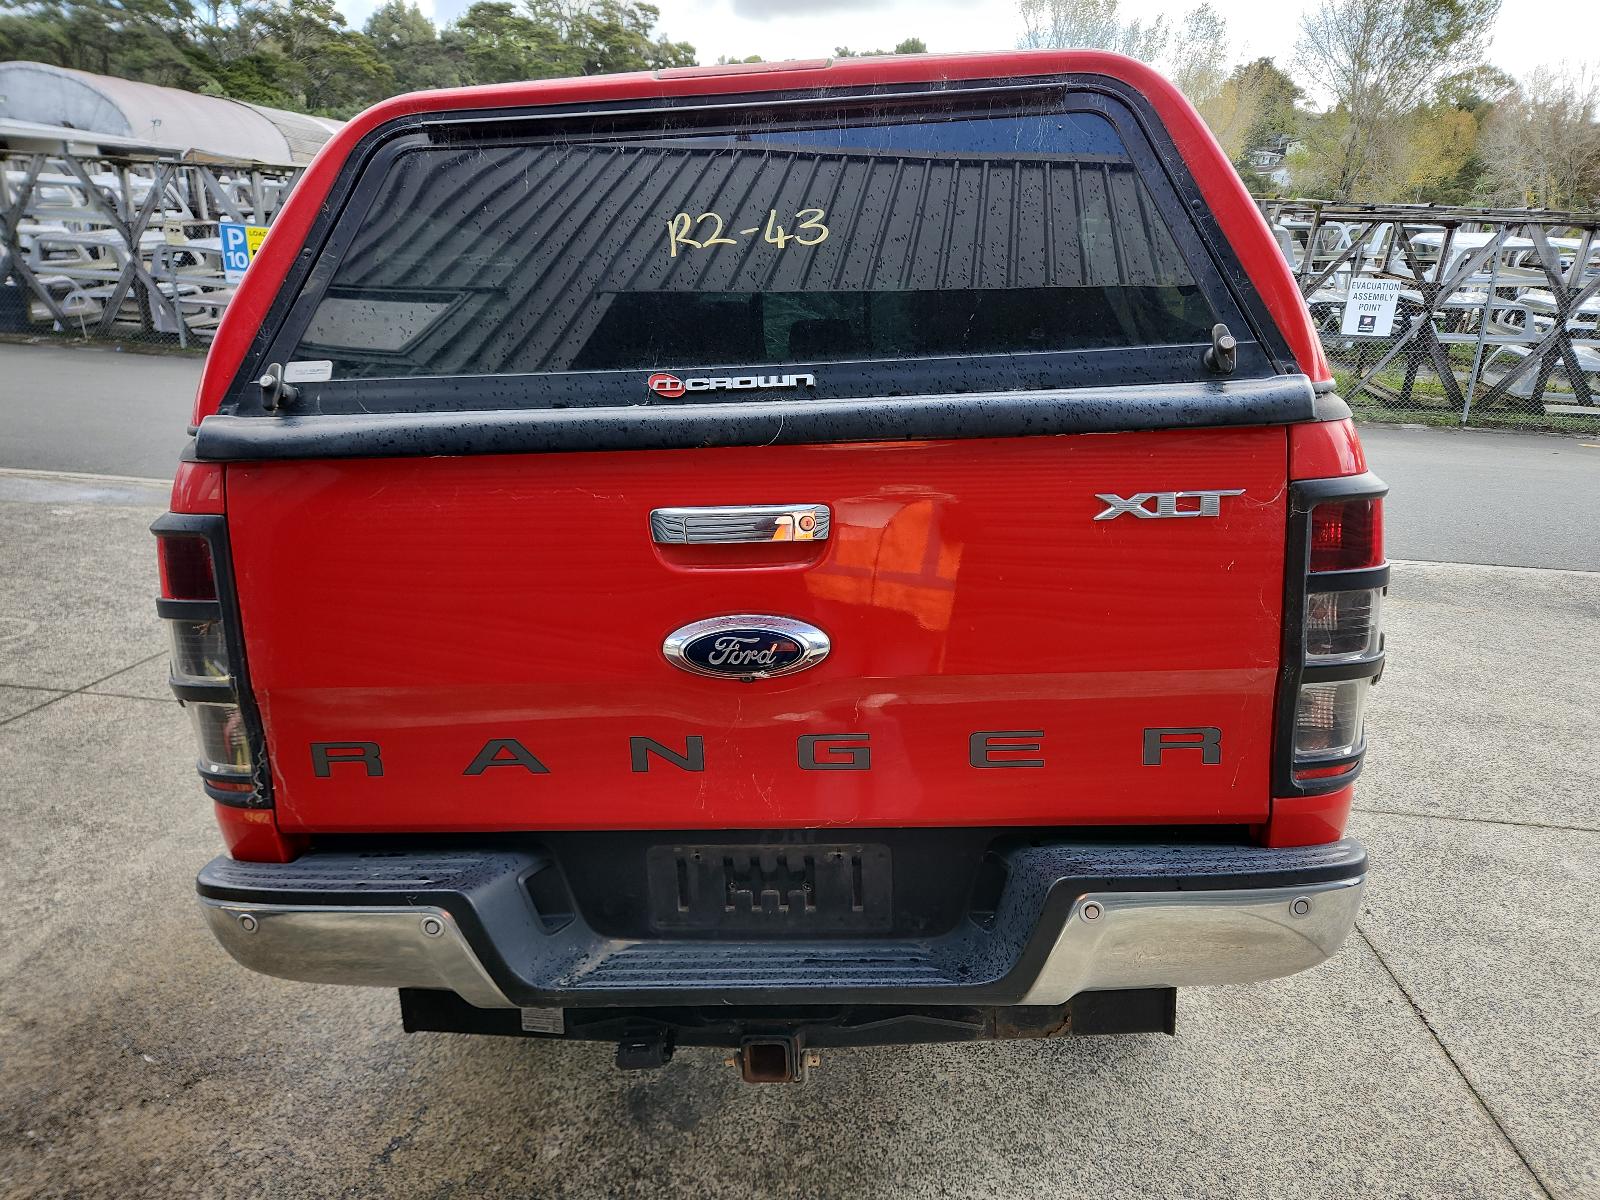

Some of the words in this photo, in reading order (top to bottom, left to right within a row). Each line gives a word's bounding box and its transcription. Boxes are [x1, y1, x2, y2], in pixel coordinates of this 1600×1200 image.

[227, 228, 244, 250] P
[667, 209, 829, 257] R2-43
[226, 251, 249, 269] 10
[1351, 281, 1400, 291] EVACUATION
[1352, 292, 1395, 302] ASSEMBLY
[1358, 303, 1382, 312] POINT
[686, 374, 816, 391] CROWN
[1093, 489, 1247, 521] XLT
[708, 636, 778, 665] Ford
[310, 726, 1222, 778] RANGER
